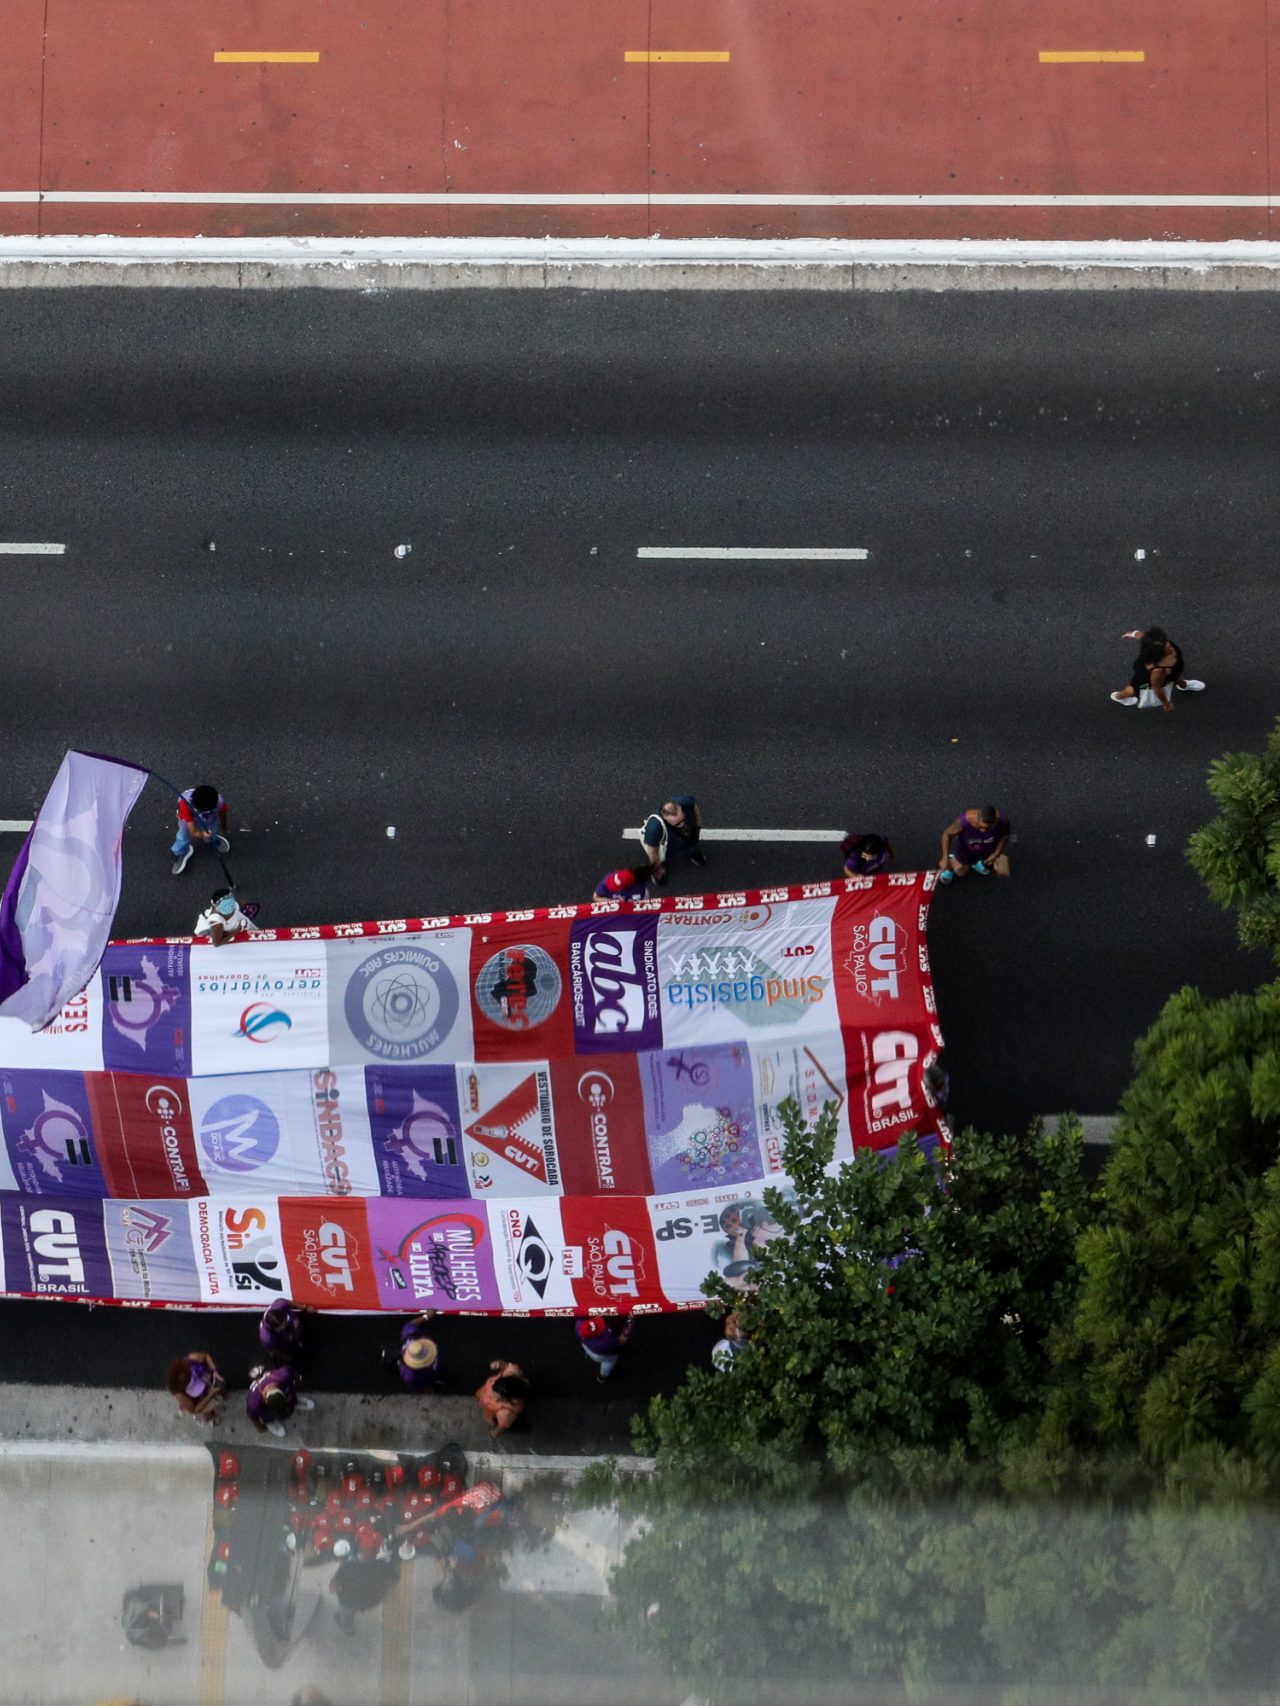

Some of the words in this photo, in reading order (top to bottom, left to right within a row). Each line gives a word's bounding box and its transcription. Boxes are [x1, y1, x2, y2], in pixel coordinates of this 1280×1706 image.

[676, 901, 703, 909] CUT
[249, 933, 277, 941] CUT
[292, 931, 320, 940] CUT
[335, 927, 364, 937] CUT
[378, 923, 407, 934] CUT
[853, 925, 868, 952] SÃO
[644, 940, 656, 991] SINDICATO
[784, 945, 815, 957] CUT
[869, 915, 900, 1000] CUT
[295, 969, 321, 977] CUT
[360, 960, 382, 978] ABC
[589, 933, 644, 1033] abc
[854, 954, 868, 995] PAULO
[199, 979, 321, 994] aeroviários
[669, 975, 825, 1010] Sindgasista
[648, 993, 658, 1019] DOS
[366, 1028, 441, 1057] MULHERES
[872, 1030, 919, 1110] CUT
[542, 1127, 552, 1138] DE
[871, 1108, 920, 1132] BRASIL
[163, 1126, 189, 1188] CONTRAF
[504, 1145, 538, 1171] CUT
[543, 1137, 559, 1186] SOROCABA
[594, 1114, 615, 1187] CONTRAF
[198, 1202, 211, 1264] DEMOCRACIA
[509, 1209, 522, 1239] CNQ
[30, 1209, 85, 1282] CUT
[304, 1229, 319, 1254] SÃO
[588, 1237, 603, 1262] SÃO
[306, 1251, 322, 1287] PAULO
[319, 1222, 354, 1292] CUT
[446, 1229, 481, 1301] MULHERES
[603, 1230, 639, 1297] CUT
[37, 1283, 90, 1293] BRASIL
[208, 1268, 220, 1295] LUTA
[409, 1254, 434, 1298] LUTA
[591, 1263, 606, 1296] PAULO
